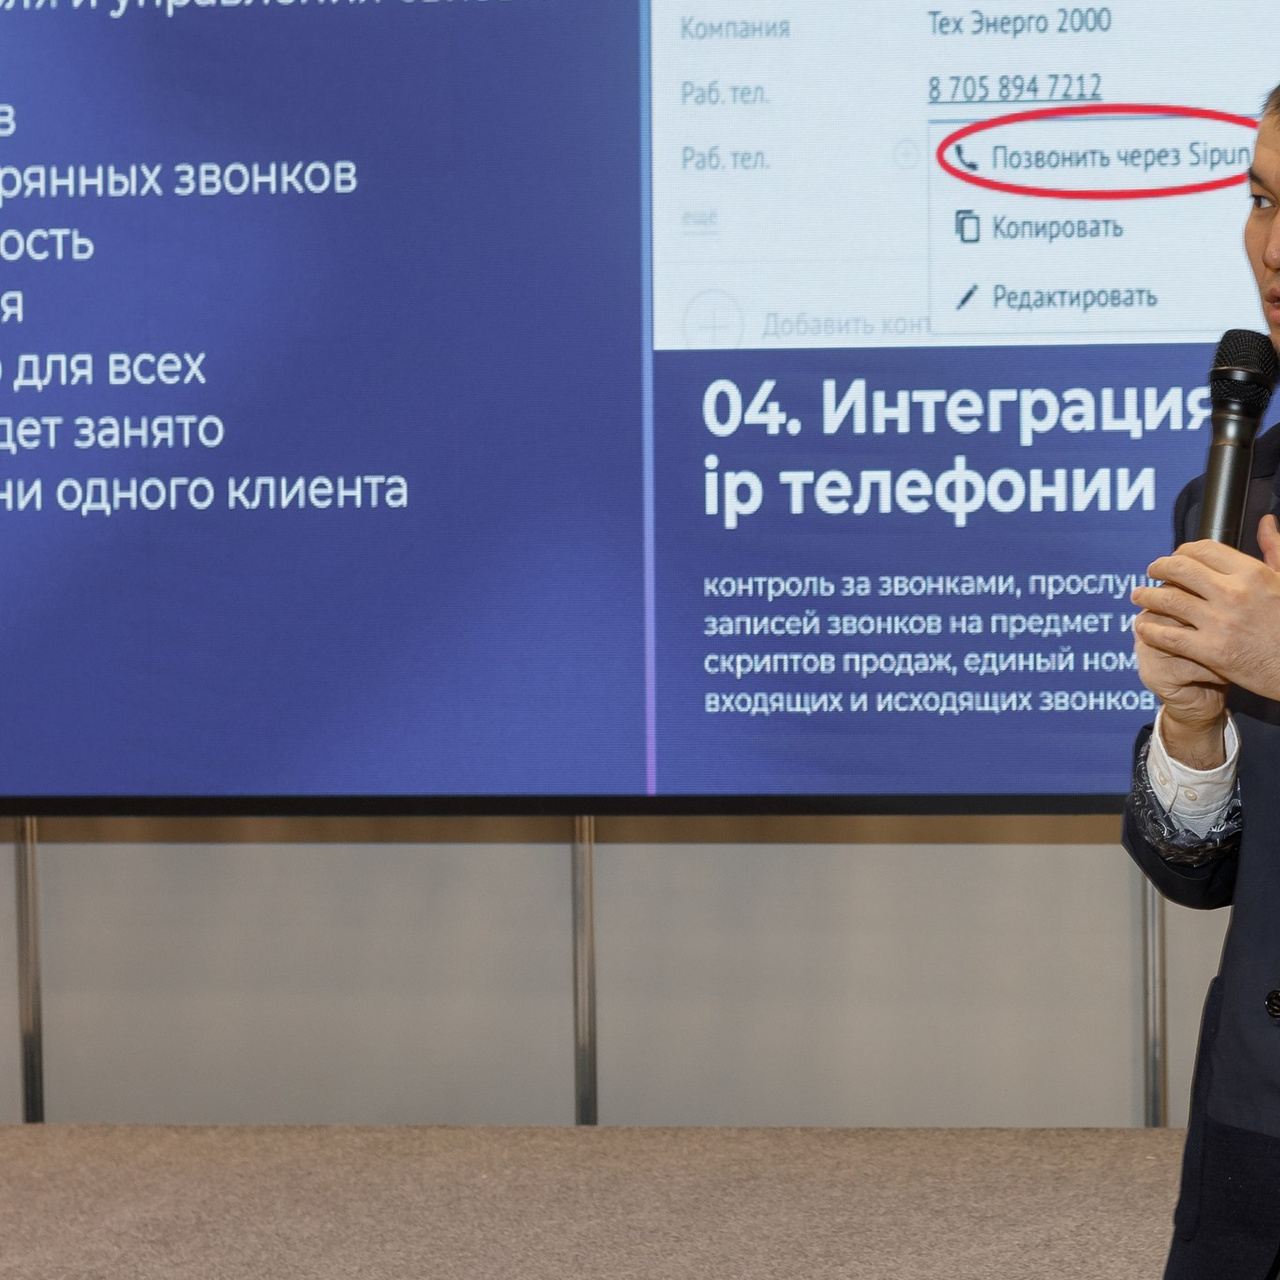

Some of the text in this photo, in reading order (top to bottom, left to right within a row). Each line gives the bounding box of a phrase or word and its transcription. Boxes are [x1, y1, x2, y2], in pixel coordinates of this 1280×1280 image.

[680, 16, 791, 41] Компания
[927, 6, 1112, 39] Тех Энерго 2000
[681, 79, 770, 106] Раб. тел.
[928, 72, 1102, 101] 8 705 894 7212
[681, 144, 770, 171] Раб. тел.
[992, 141, 1251, 173] Позвонить через Sipun
[0, 160, 358, 209] рянных звонков
[0, 228, 95, 262] ость
[993, 215, 1124, 244] Копировать
[993, 283, 1159, 313] Редактировать
[761, 311, 875, 340] Добавить
[12, 353, 93, 392] для
[108, 352, 206, 386] всех
[702, 378, 1212, 447] 04. Интеграция
[74, 415, 225, 449] занято
[56, 477, 215, 517] одного
[228, 475, 408, 510] клиента
[704, 453, 1156, 530] ip телефонии
[704, 576, 836, 602] контроль
[841, 575, 871, 597] за
[878, 574, 1022, 599] звонками,
[704, 609, 820, 636] записей
[827, 614, 942, 635] звонков
[949, 614, 983, 634] на
[990, 613, 1113, 639] предмет
[703, 653, 836, 680] скриптов
[843, 652, 958, 679] продаж,
[963, 646, 1075, 676] единый
[704, 692, 844, 716] входящих
[850, 692, 868, 712] и
[876, 691, 1033, 716] исходящих
